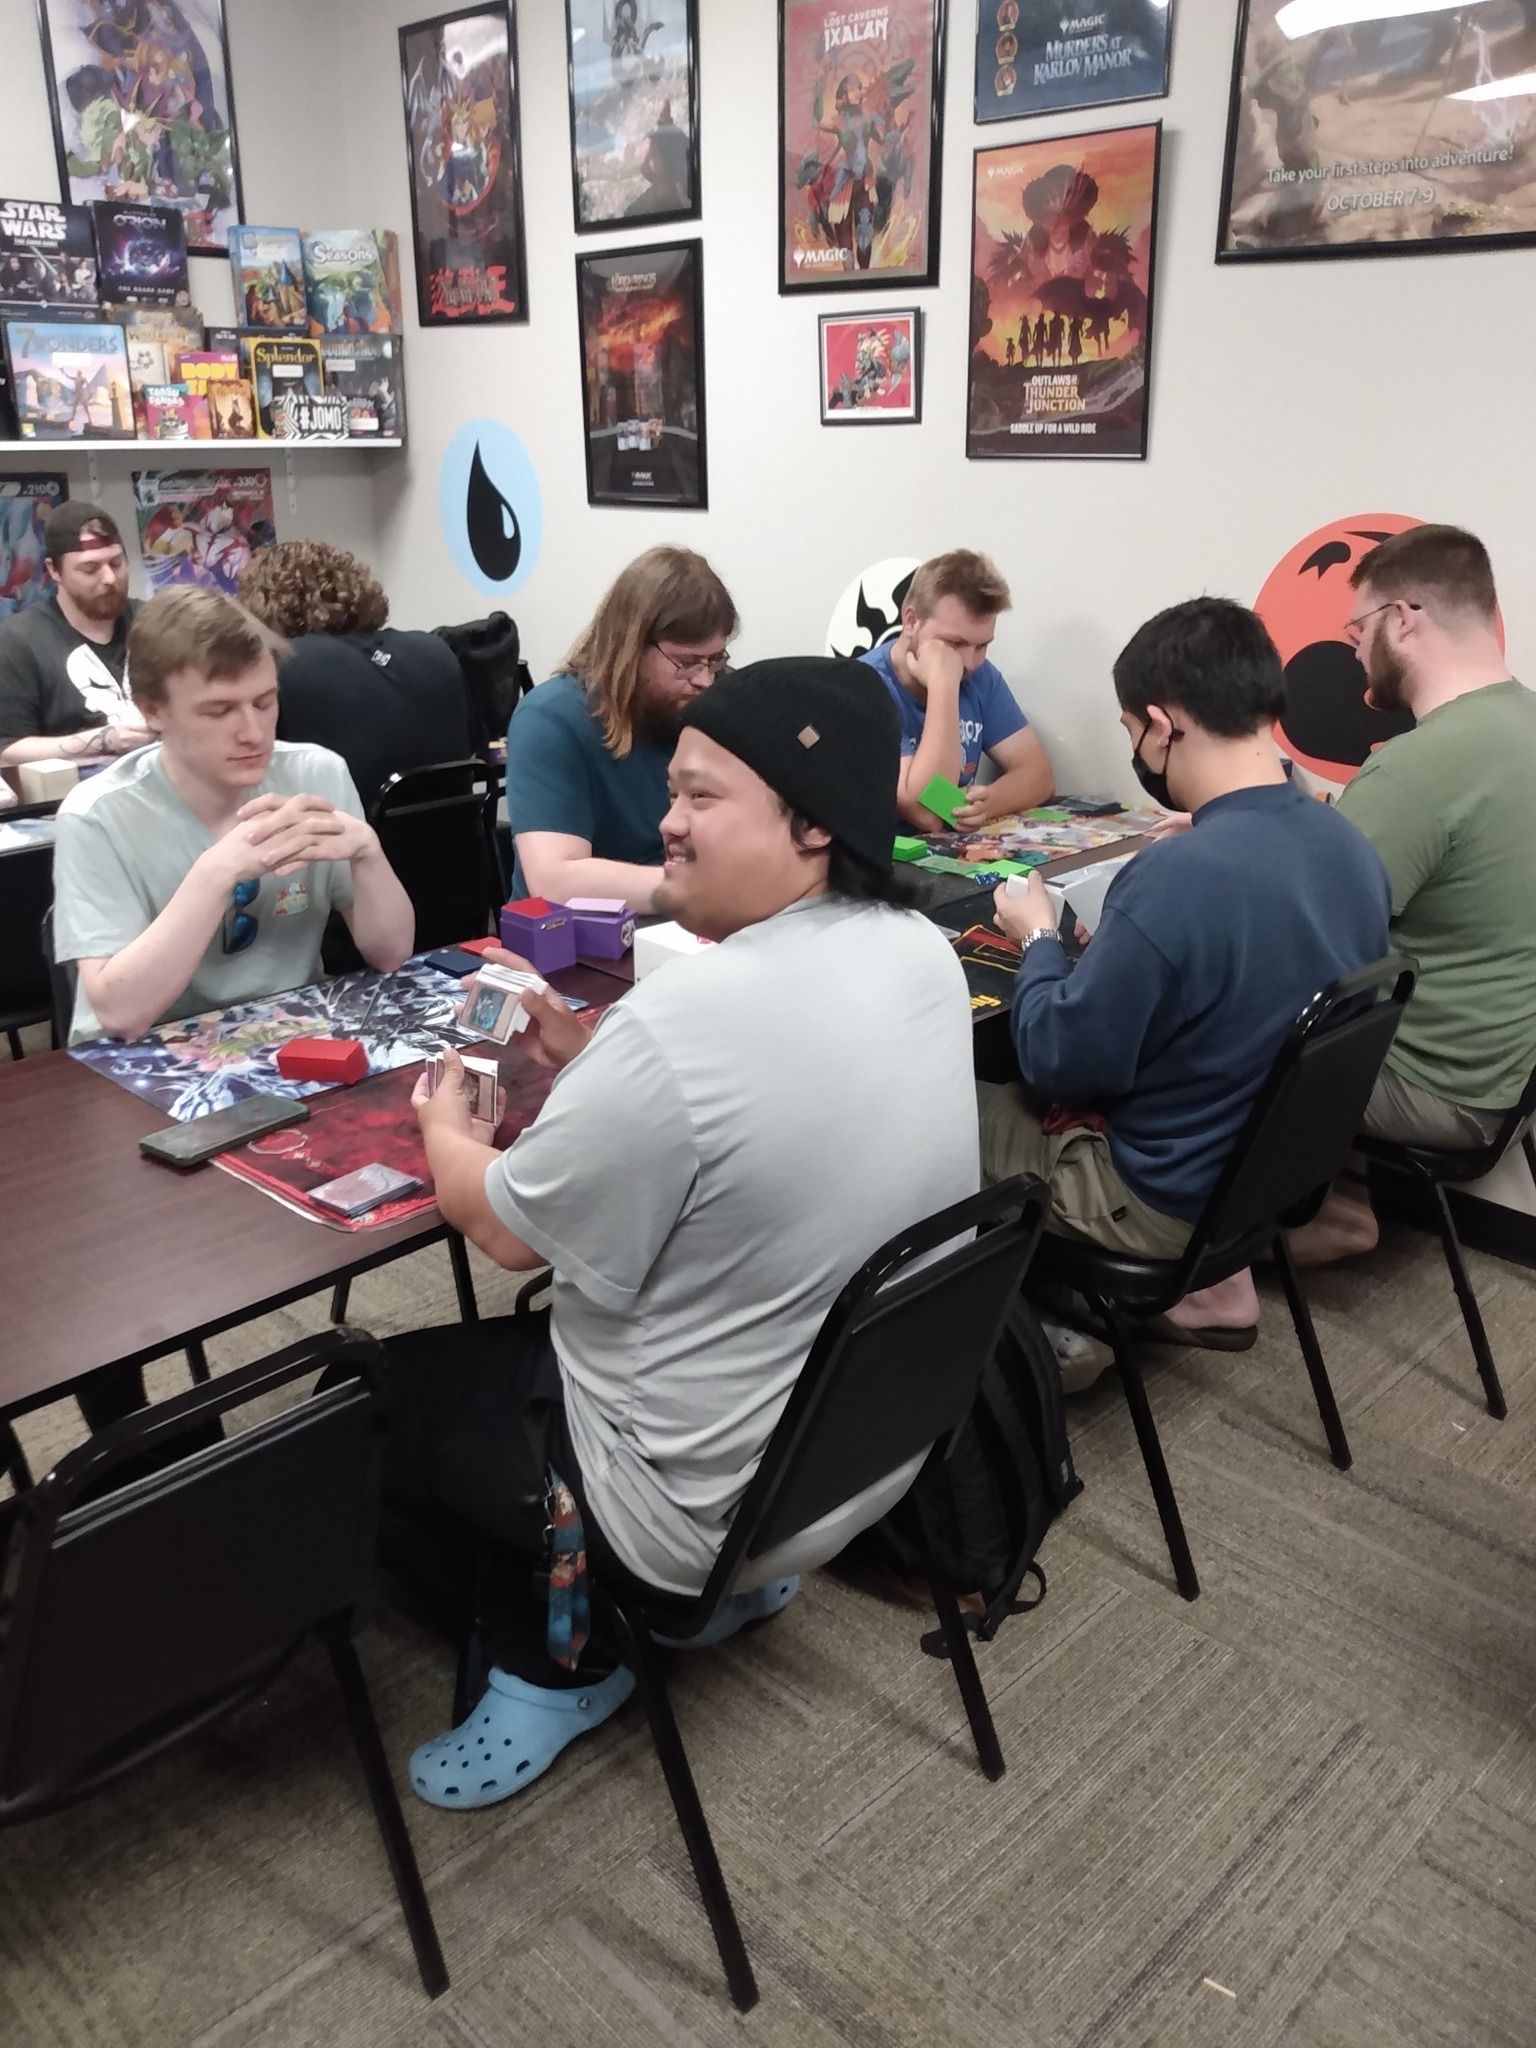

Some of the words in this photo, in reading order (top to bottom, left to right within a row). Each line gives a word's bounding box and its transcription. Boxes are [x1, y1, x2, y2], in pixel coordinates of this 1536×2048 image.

[1069, 13, 1106, 28] MAGIC
[824, 17, 888, 53] IXALAN
[1046, 33, 1109, 61] MURDERS
[1109, 35, 1123, 51] AT
[1033, 58, 1084, 86] KARLOV
[1083, 48, 1132, 77] MANOR
[1267, 167, 1297, 184] Take
[1298, 167, 1329, 184] your
[1330, 162, 1358, 178] first
[1360, 159, 1399, 177] steps
[1401, 156, 1429, 171] into
[1431, 143, 1514, 169] adventure!
[1327, 190, 1404, 211] OCTOBER
[1408, 187, 1435, 205] 7-9
[0, 202, 66, 222] STAR
[0, 219, 67, 240] WARS
[313, 243, 373, 264] Seasons
[805, 247, 848, 263] MAGIC
[16, 328, 34, 358] 7
[36, 334, 118, 353] WONDERS
[255, 345, 316, 369] Splendor
[1031, 374, 1071, 386] OUTLAWS
[1023, 382, 1079, 400] THUNDER
[1025, 398, 1086, 414] JUNCTION
[300, 406, 342, 430] #JOMO
[1010, 422, 1034, 434] SADDLE
[1063, 423, 1080, 434] WILD
[1081, 423, 1096, 434] RIDE
